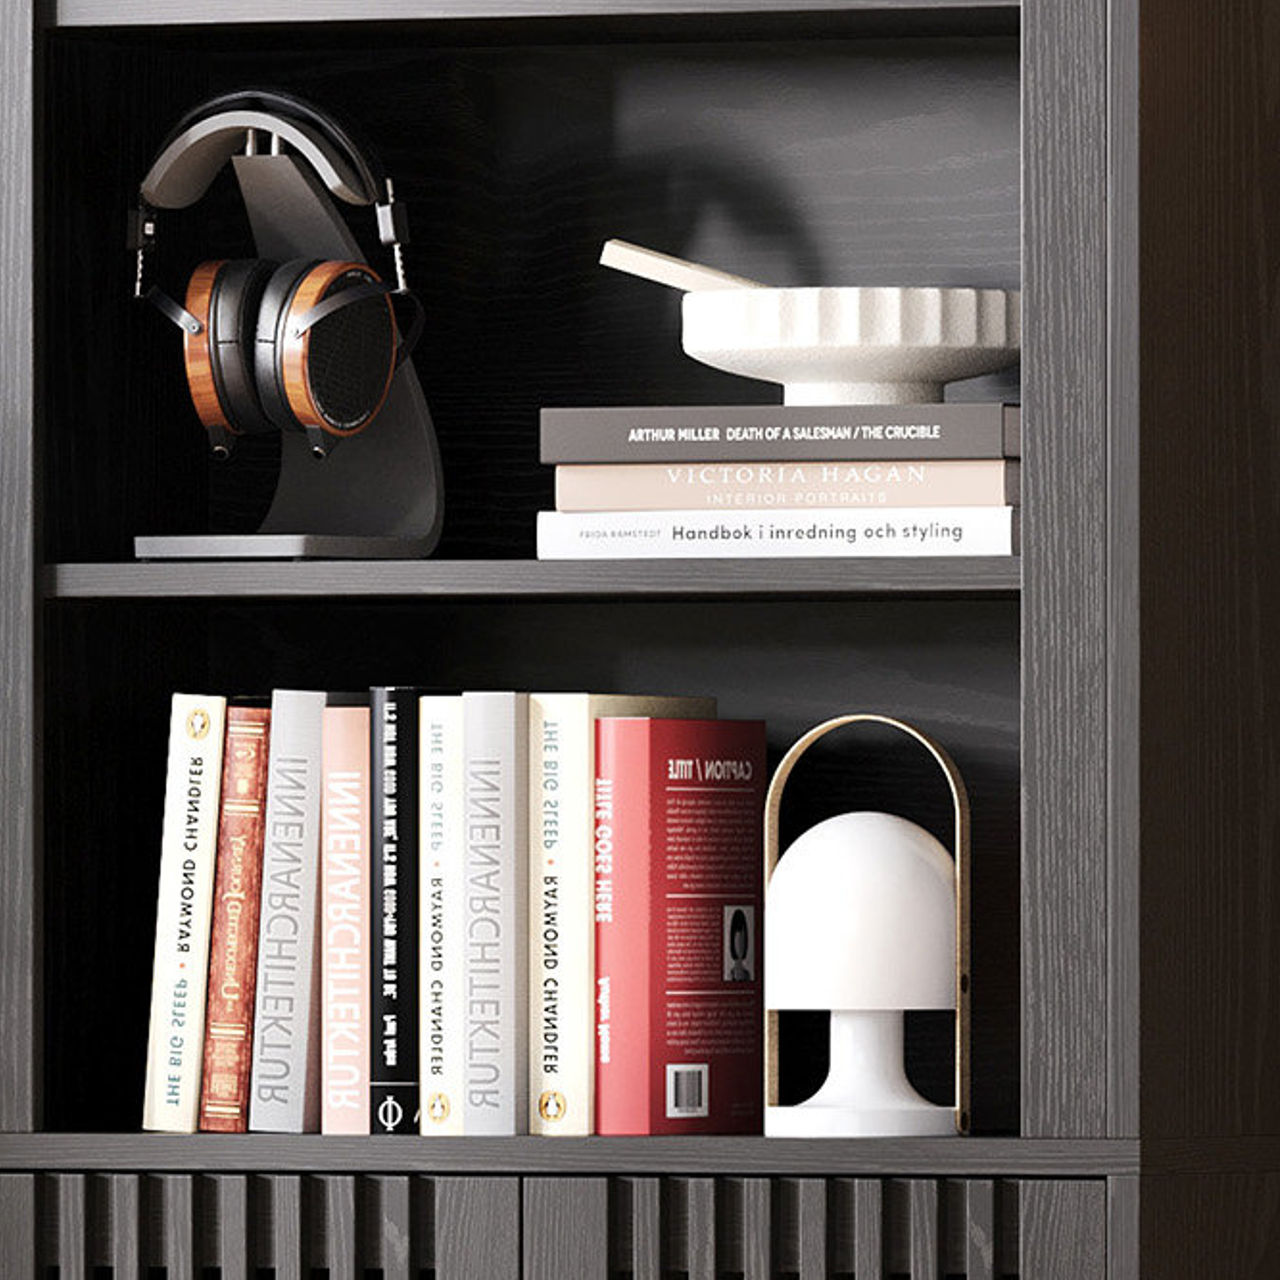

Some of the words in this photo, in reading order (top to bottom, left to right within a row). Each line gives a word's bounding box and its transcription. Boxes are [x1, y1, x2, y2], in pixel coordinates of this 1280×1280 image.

[628, 427, 675, 441] ARTHUR
[678, 427, 720, 441] MILLER
[726, 426, 764, 440] DEATH
[765, 426, 781, 440] OF
[782, 426, 791, 440] A
[792, 425, 852, 440] SALESMAN
[860, 425, 883, 439] THE
[885, 424, 941, 439] CRUCIBLE
[667, 467, 806, 483] VICTORIA
[821, 465, 927, 483] HAGAN
[707, 493, 786, 505] INTERIOR
[795, 491, 887, 504] PORTRAITS
[672, 525, 752, 540] Handbok
[759, 525, 764, 539] i
[770, 523, 857, 543] inredning
[864, 523, 896, 538] och
[902, 522, 964, 541] styling
